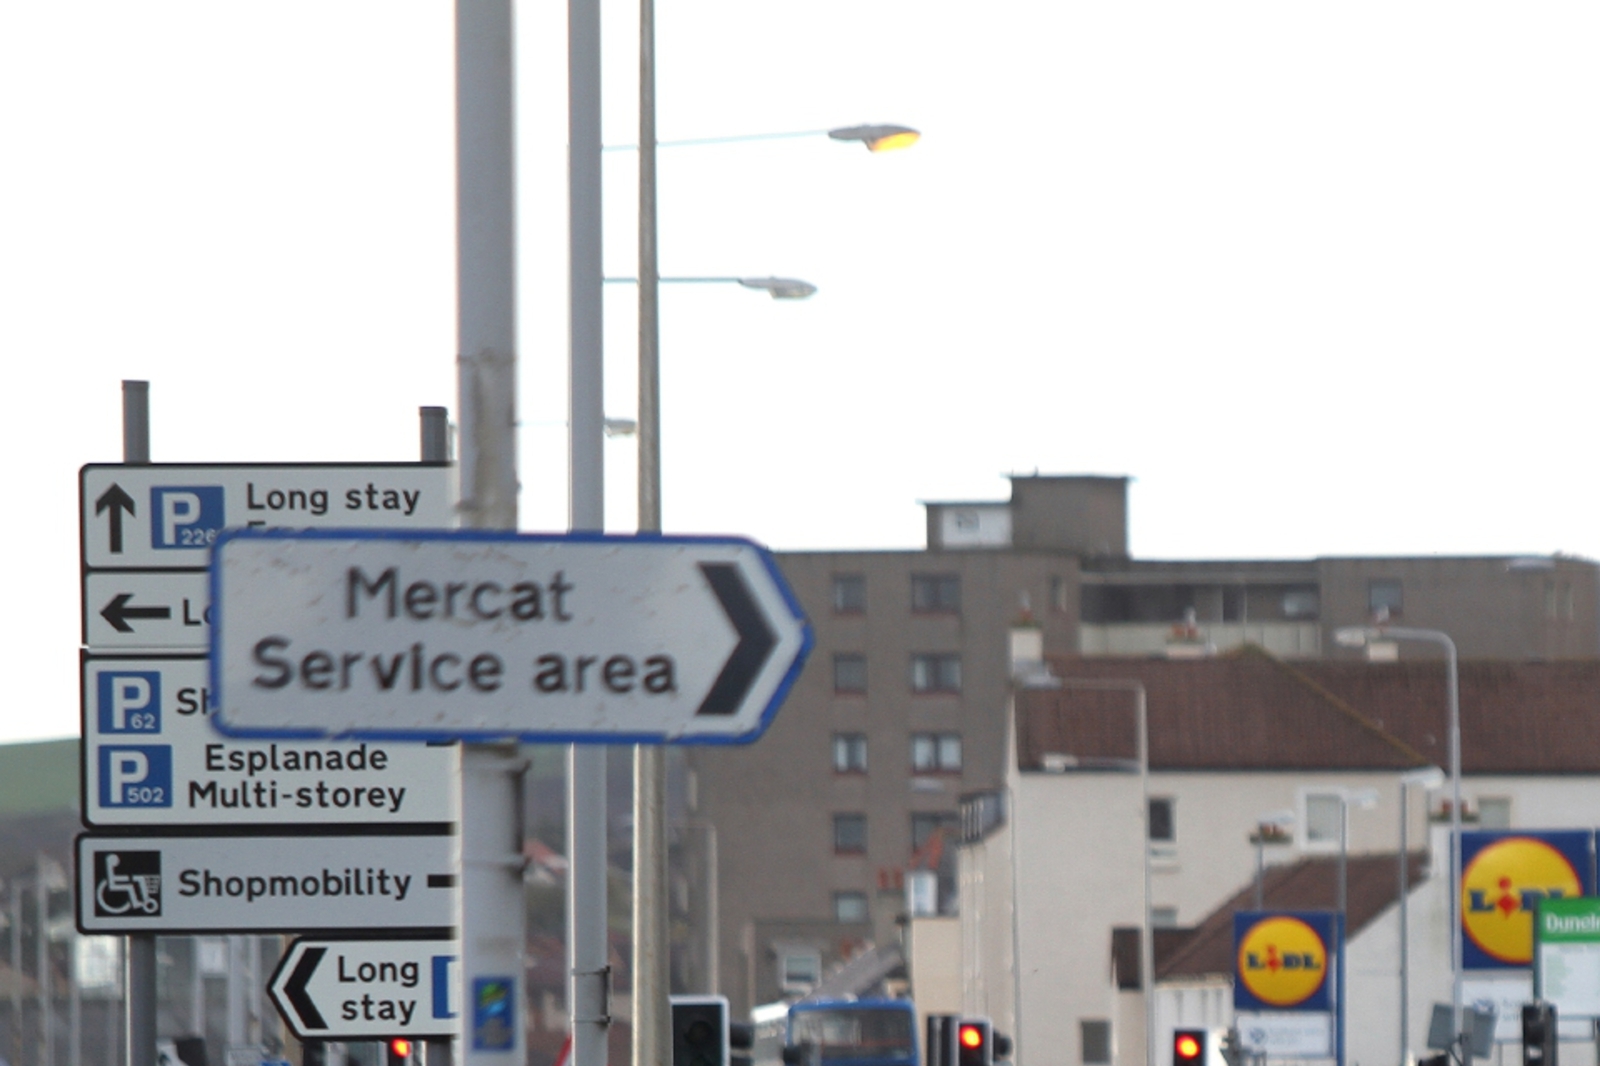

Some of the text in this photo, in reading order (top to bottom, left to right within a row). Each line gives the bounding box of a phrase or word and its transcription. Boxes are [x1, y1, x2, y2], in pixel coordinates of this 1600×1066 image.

[247, 482, 421, 516] Long stay
[162, 491, 201, 546] P
[345, 566, 574, 621] Mercat
[252, 636, 678, 694] Service area
[111, 676, 156, 730] P 62
[205, 743, 388, 776] Esplanade
[110, 750, 164, 804] P 502
[189, 780, 406, 813] Multi-storey
[179, 868, 411, 902] Shopmobility
[338, 955, 420, 988] Long
[341, 994, 417, 1026] stay
